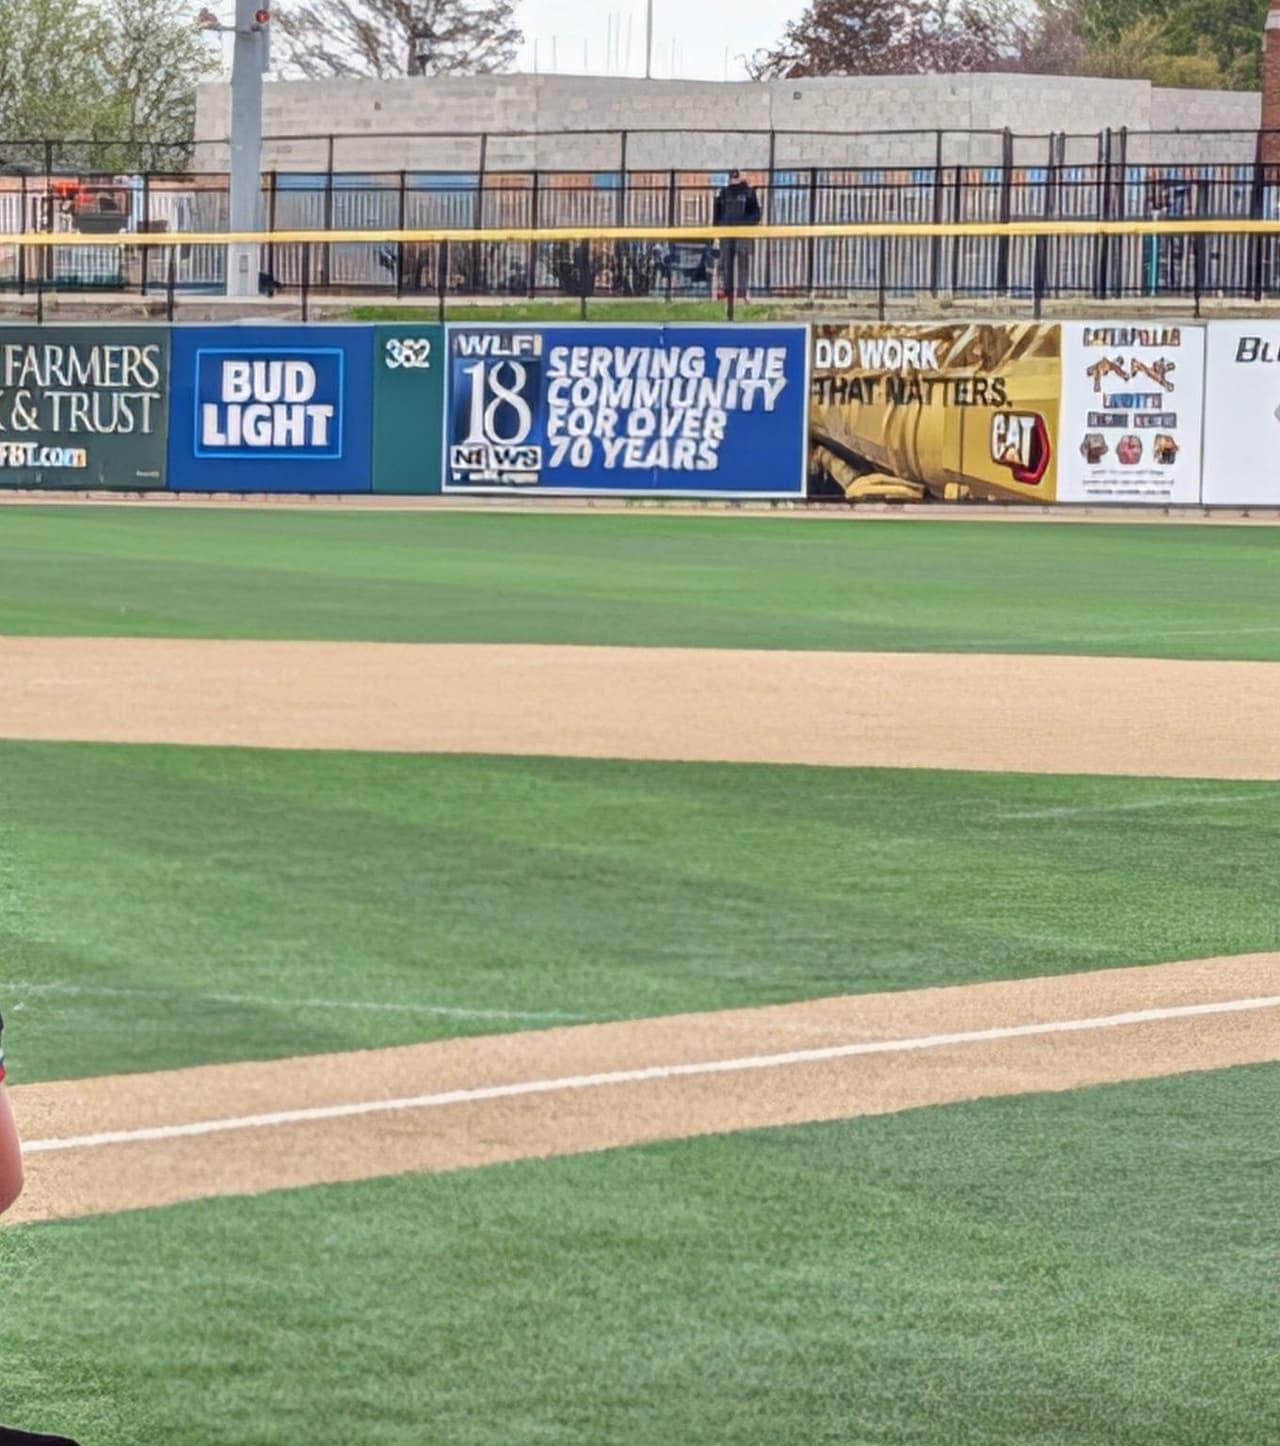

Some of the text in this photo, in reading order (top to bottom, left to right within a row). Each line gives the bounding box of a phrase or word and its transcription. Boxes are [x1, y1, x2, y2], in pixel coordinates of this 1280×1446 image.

[458, 334, 542, 356] WLFI
[815, 339, 940, 369] DO WORK
[5, 344, 160, 388] FARMERS
[546, 346, 787, 380] SERVING THE
[222, 360, 317, 403] BUD
[547, 378, 787, 411] COMMUNITY
[814, 377, 880, 405] THAT
[11, 390, 42, 431] &
[43, 391, 160, 434] TRUST
[462, 360, 532, 445] 18
[202, 403, 334, 446] LIGHT
[548, 407, 727, 439] FOR OVER
[549, 436, 720, 470] 70 YEARS
[993, 413, 1037, 468] CAT
